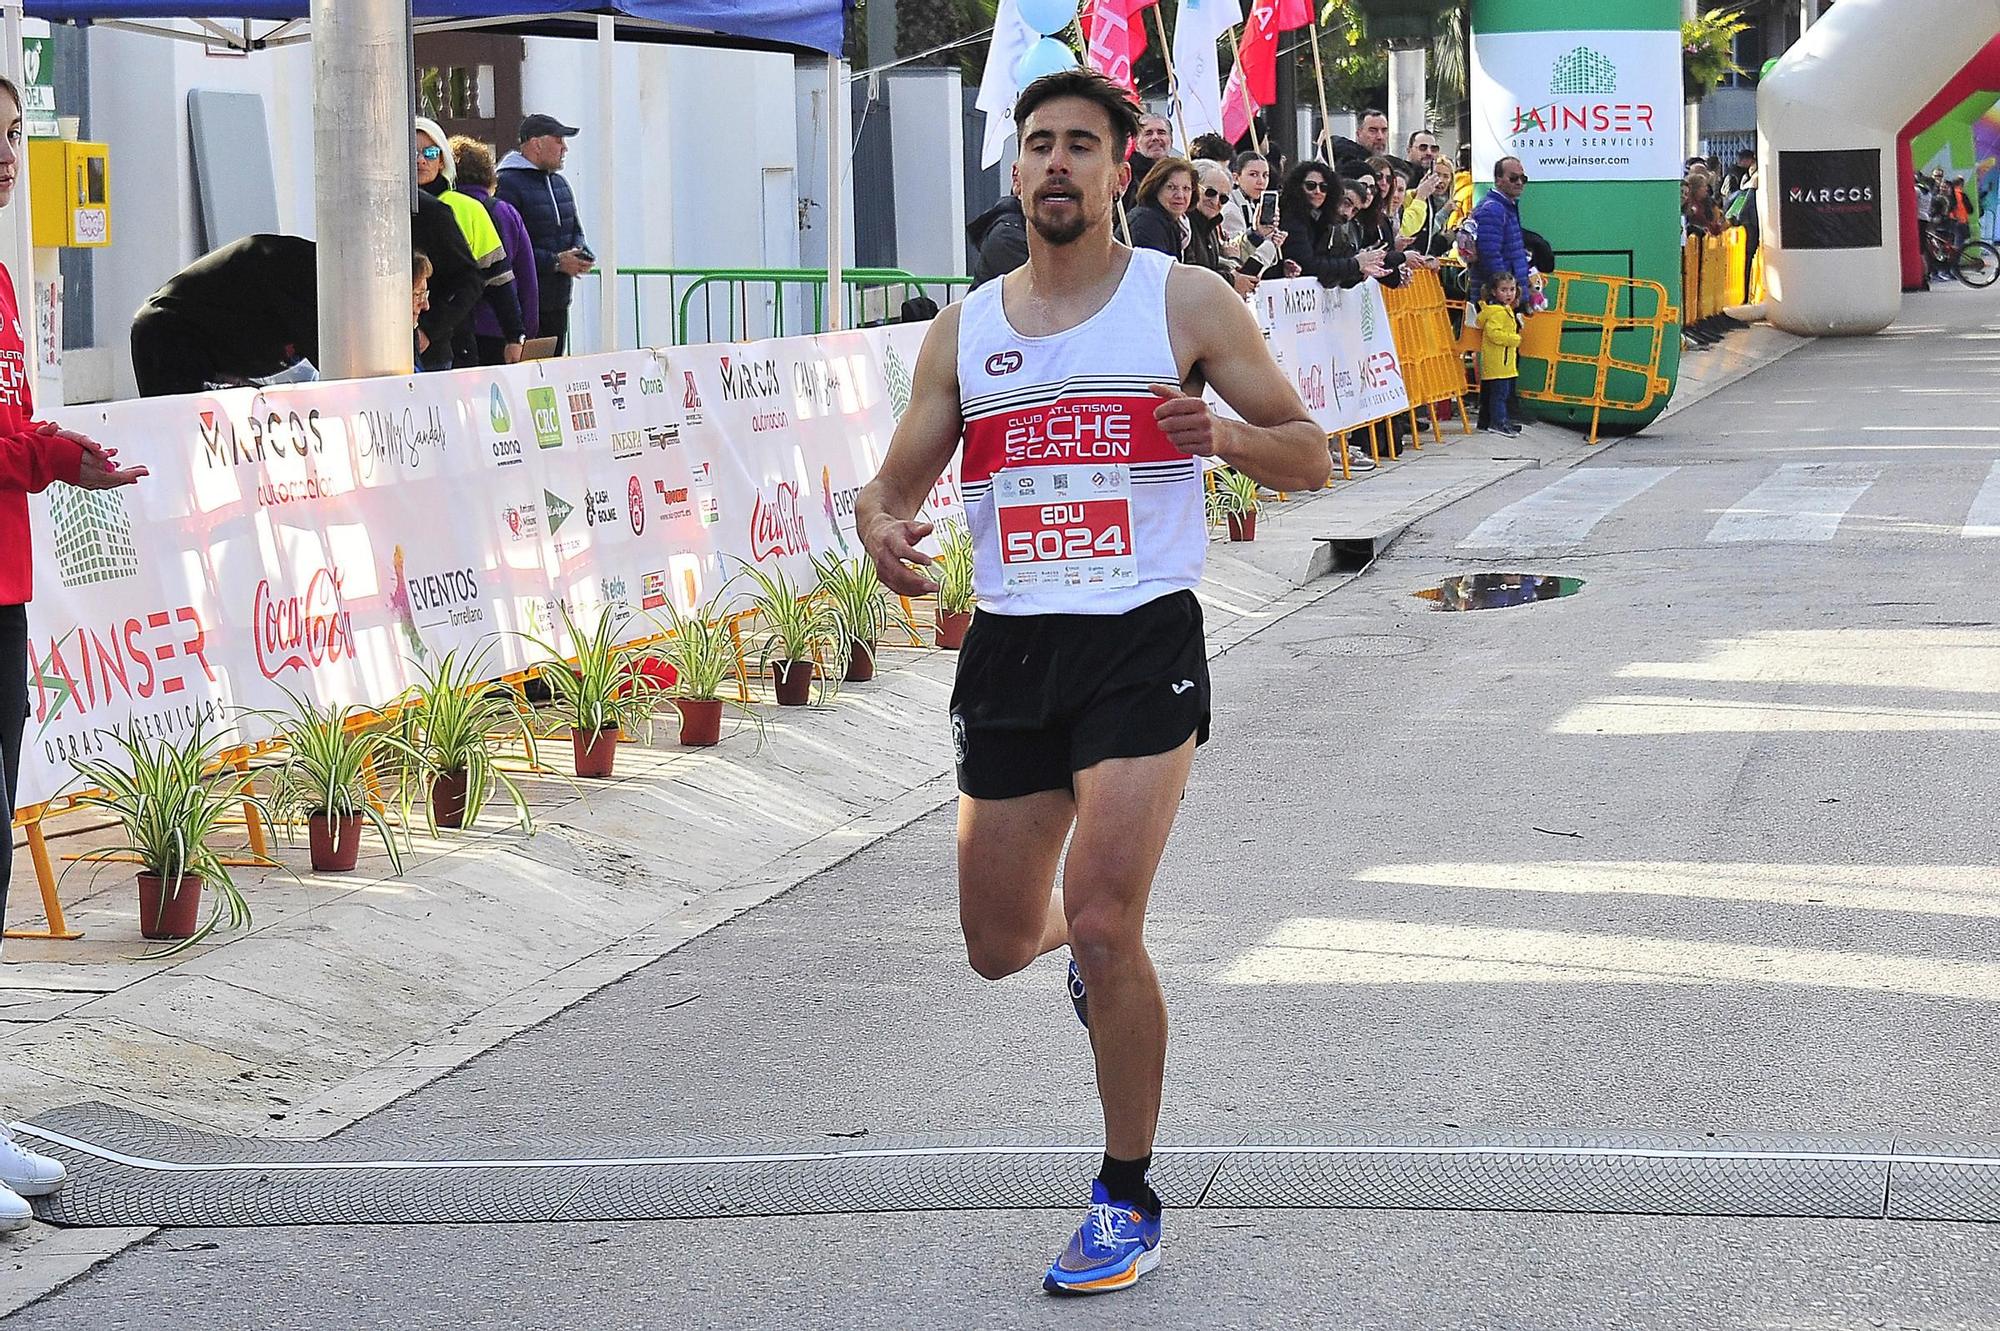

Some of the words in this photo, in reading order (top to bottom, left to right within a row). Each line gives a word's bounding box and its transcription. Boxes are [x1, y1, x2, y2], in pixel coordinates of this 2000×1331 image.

[1511, 105, 1654, 133] JAINSER
[1512, 138, 1554, 148] OBRAS
[1564, 138, 1571, 147] Y
[1582, 137, 1654, 147] SERVICIOS
[1539, 156, 1630, 167] www.jainser.com
[1789, 186, 1872, 202] MARCOS
[719, 357, 780, 401] MARCOS
[536, 408, 559, 433] CRC
[1008, 414, 1043, 427] CLUB
[1048, 404, 1123, 416] ATLETISMO
[199, 409, 323, 469] MARCOS
[612, 431, 642, 452] INESPA
[1004, 415, 1131, 454] ELCHE
[1041, 504, 1085, 525] EDU
[1007, 525, 1126, 562] 5024
[408, 567, 478, 611] EVENTOS
[254, 566, 357, 680] Coca-Cola
[448, 605, 483, 627] Torrellano
[27, 606, 217, 724] JAINSER
[44, 731, 104, 764] OBRAS
[112, 722, 122, 747] Y
